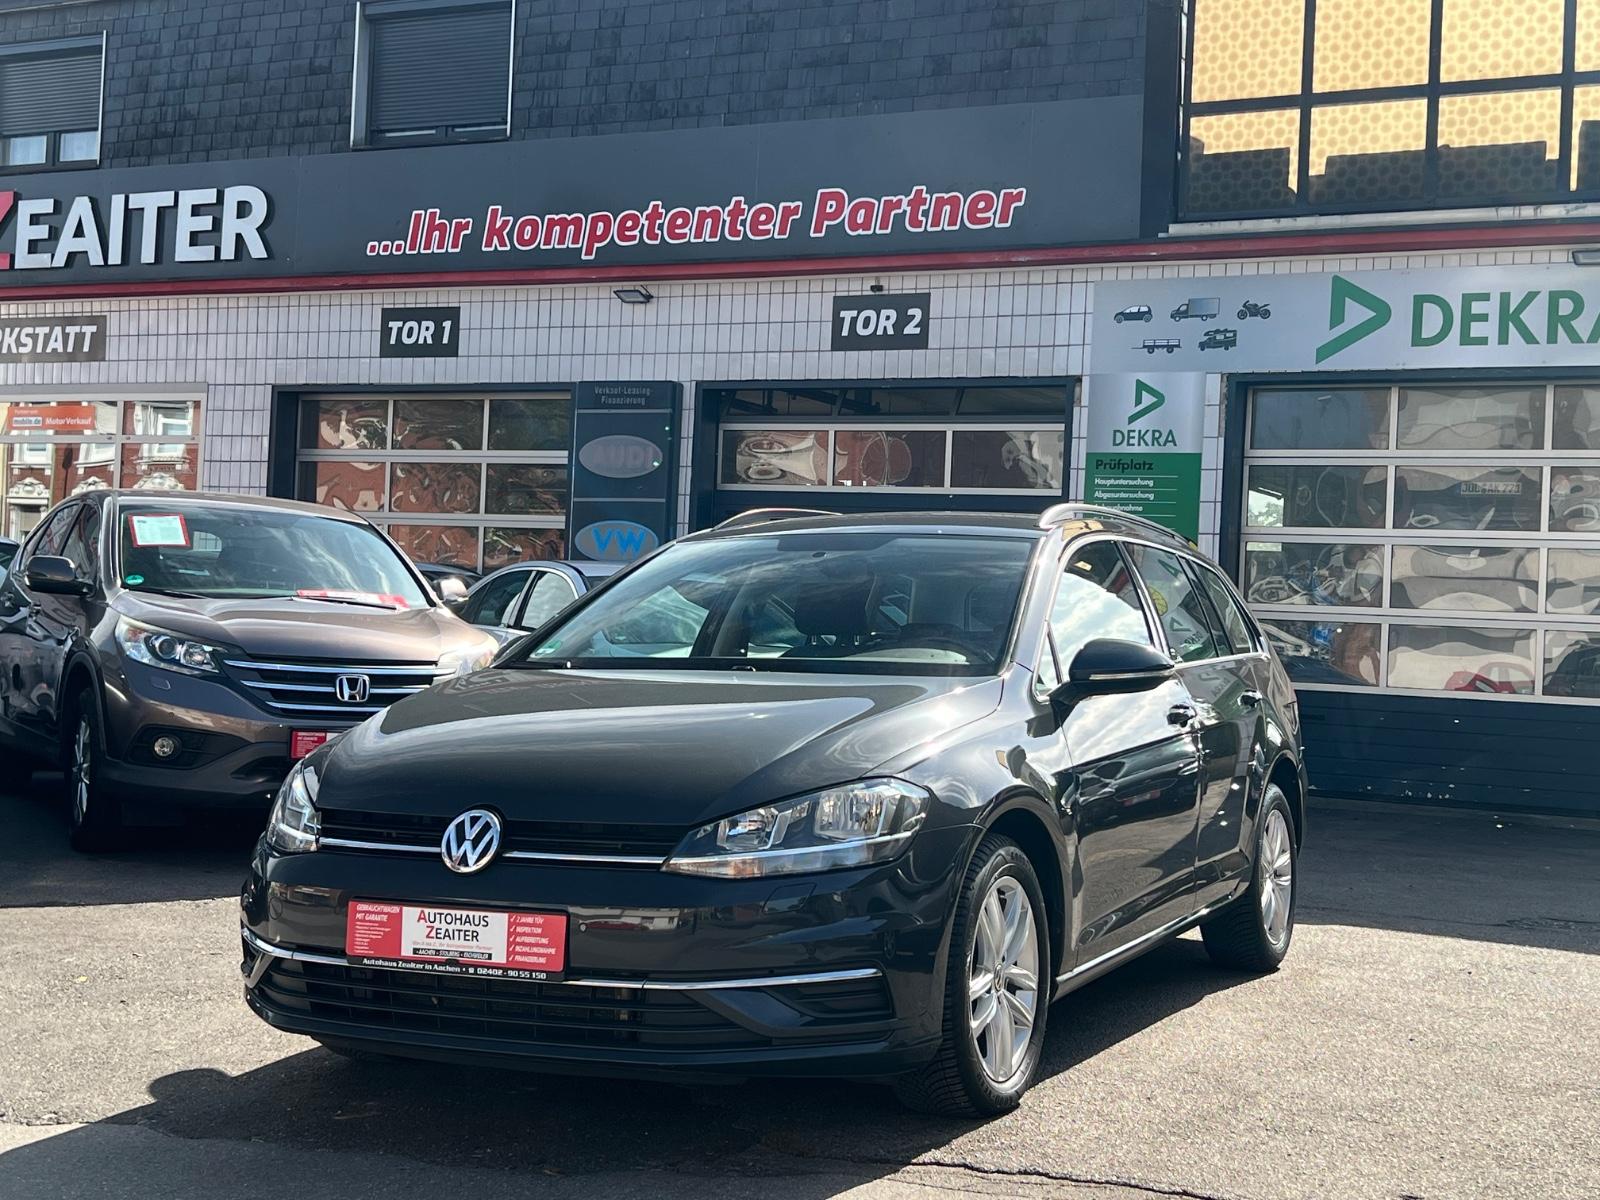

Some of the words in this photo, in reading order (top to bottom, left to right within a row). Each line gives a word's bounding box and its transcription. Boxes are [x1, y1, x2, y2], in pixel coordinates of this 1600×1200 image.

[482, 196, 802, 260] kompetenter
[810, 185, 1026, 238] Partner
[840, 309, 896, 337] TOR
[903, 308, 923, 335] 2
[0, 325, 97, 354] KSTATT
[388, 320, 435, 345] TOR
[442, 320, 452, 345] 1
[601, 395, 646, 405] Finanzierung
[1112, 429, 1177, 447] DEKRA
[1095, 459, 1154, 473] Prüfplatz
[1094, 478, 1153, 487] Hauptuntersuchung
[1094, 491, 1155, 500] Abgasuntersuchung
[591, 528, 647, 559] VW
[417, 910, 489, 928] AUTOHAUS
[425, 925, 480, 942] ZEAITER
[363, 958, 397, 967] Autohaus
[425, 962, 432, 970] in
[433, 963, 460, 973] Aachen
[477, 968, 503, 976] 02402
